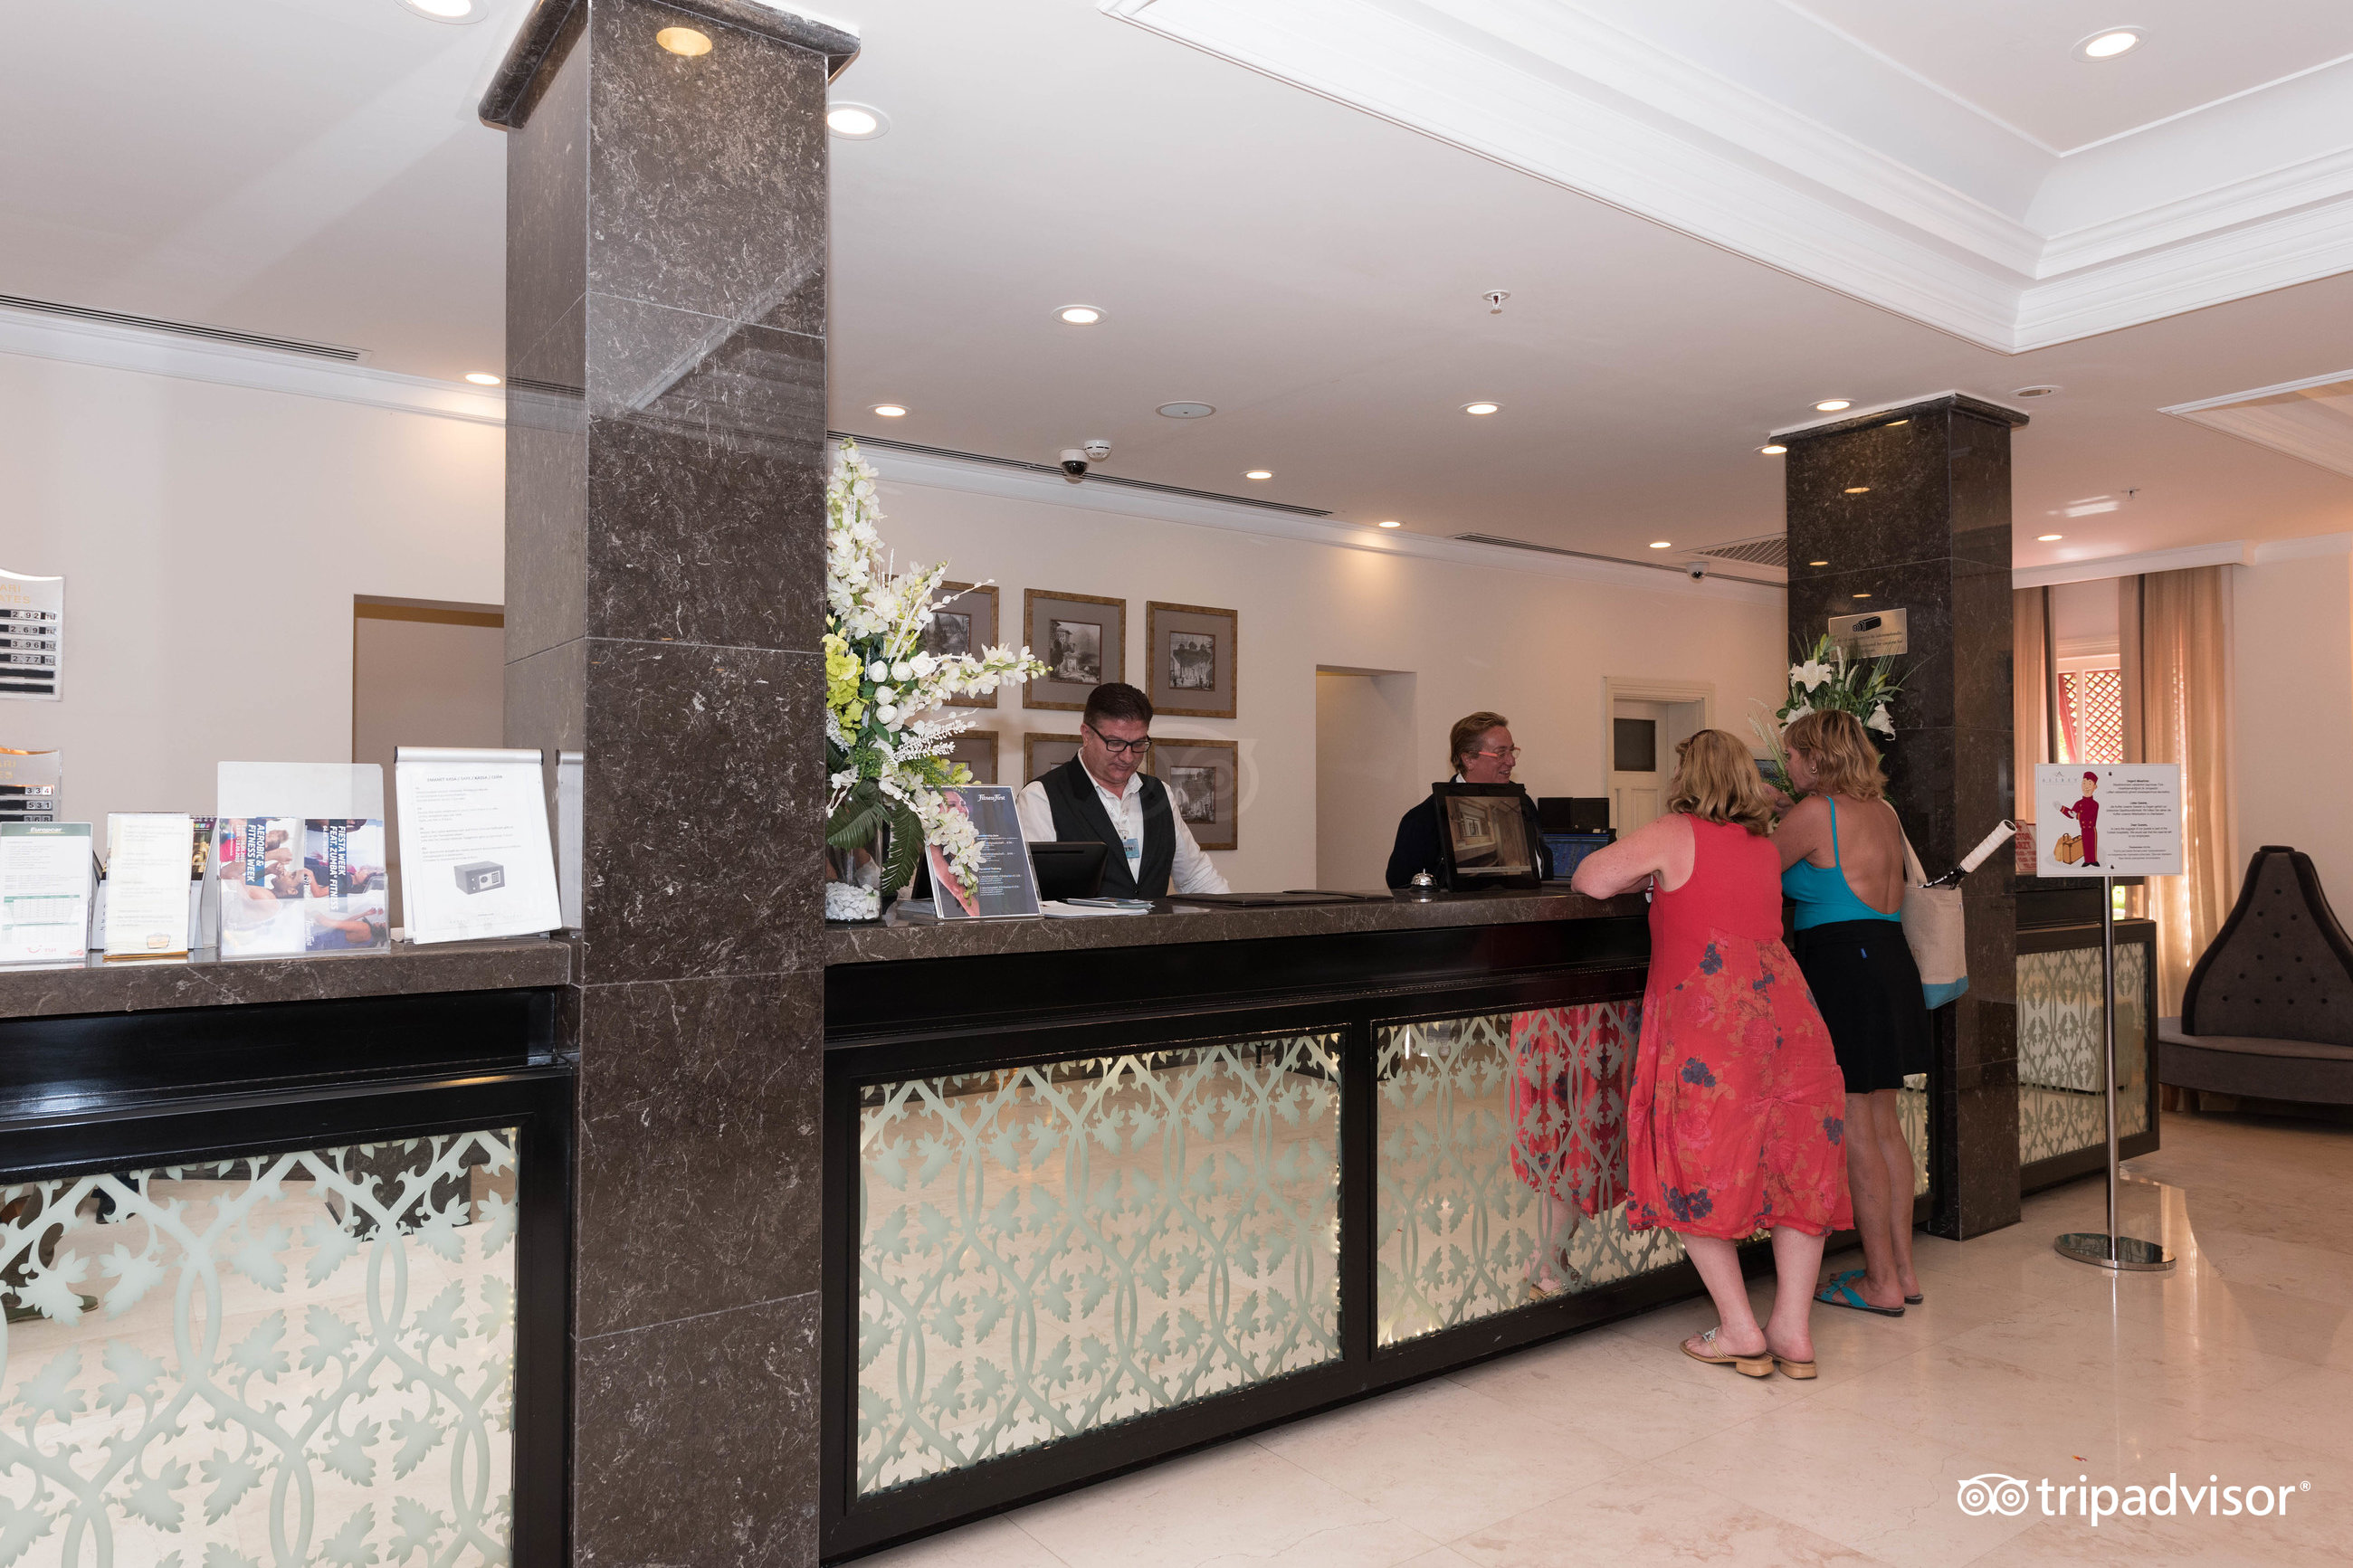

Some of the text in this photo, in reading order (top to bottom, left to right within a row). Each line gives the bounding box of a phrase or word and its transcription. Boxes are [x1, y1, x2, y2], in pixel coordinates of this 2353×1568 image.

[256, 824, 265, 860] AEROBIC
[329, 825, 338, 846] FEAT.
[247, 825, 256, 882] FITNESS WEEK
[329, 879, 338, 911] FITNESS
